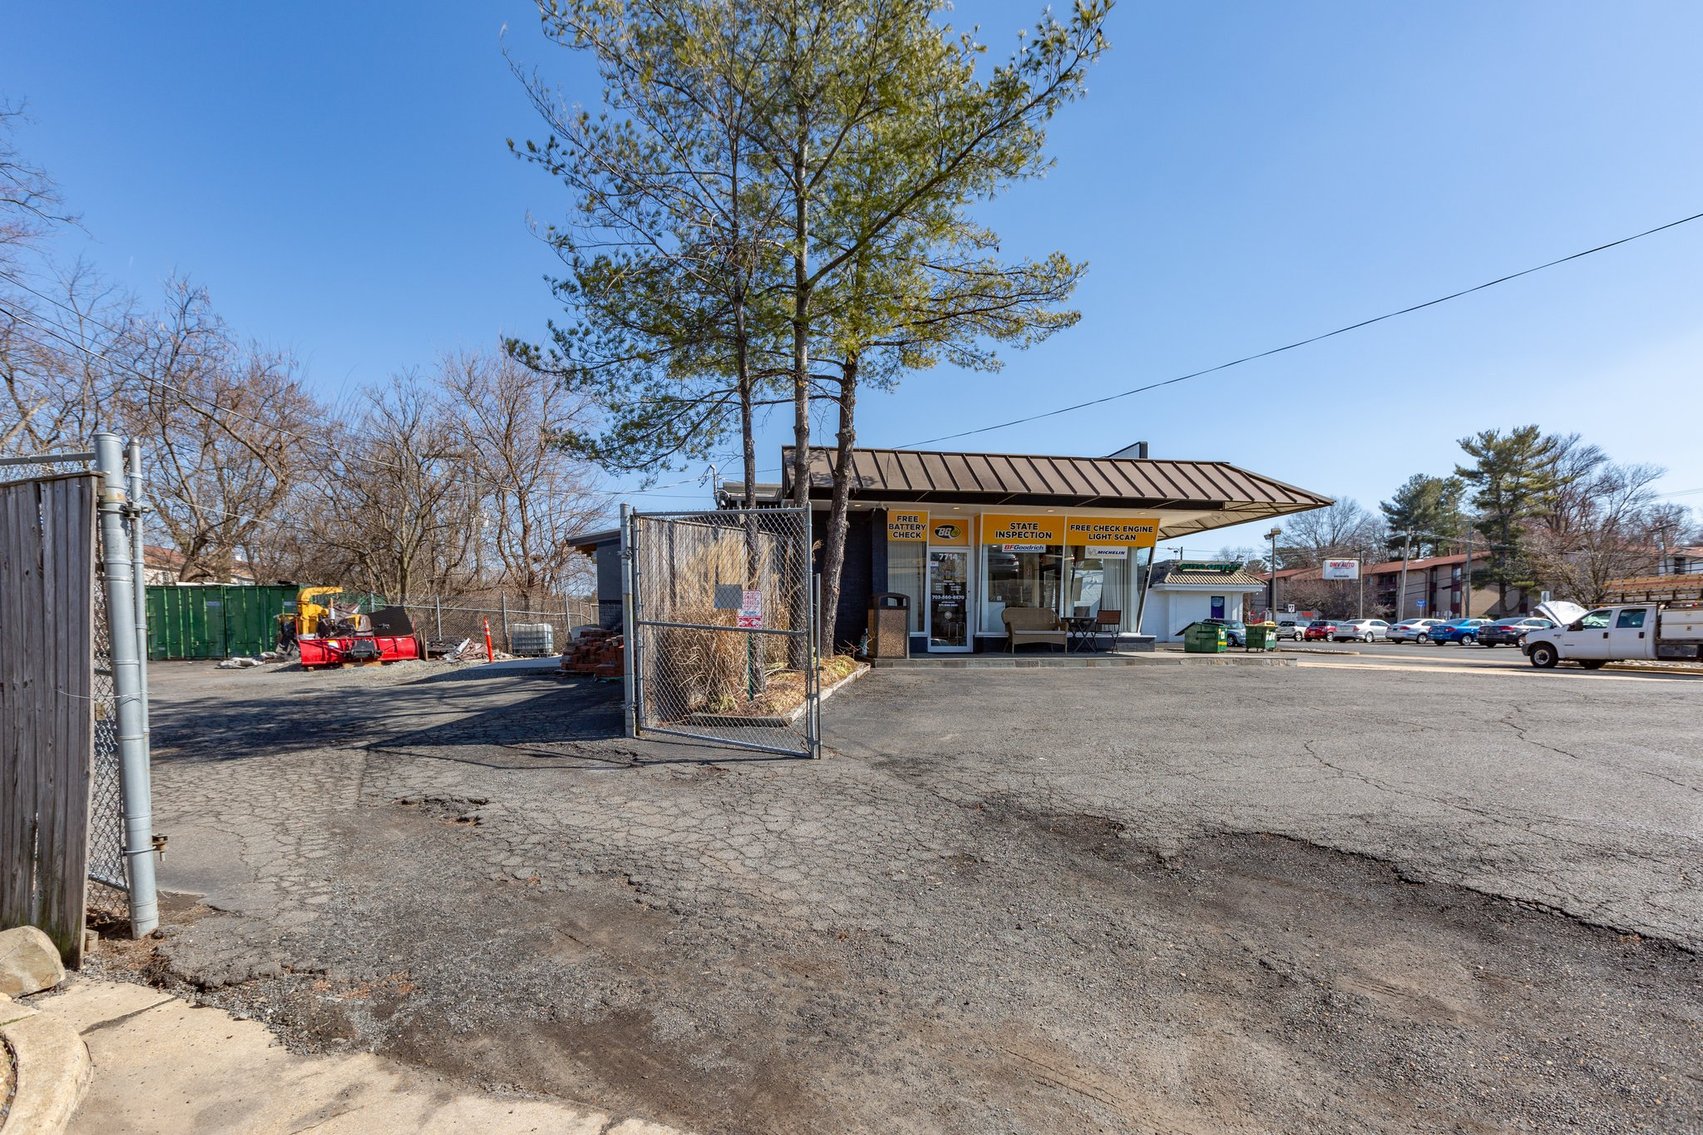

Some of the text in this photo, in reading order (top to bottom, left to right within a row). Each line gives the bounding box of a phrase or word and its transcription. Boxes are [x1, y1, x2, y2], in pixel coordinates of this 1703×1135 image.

[896, 515, 919, 523] FREE
[888, 523, 927, 531] BATTERY
[1010, 522, 1039, 531] STATE
[1070, 524, 1154, 533] FREE CHECK ENGINE
[892, 531, 922, 539] CHECK
[995, 531, 1053, 540] INSPECTION
[1088, 533, 1137, 542] LIGHT SCAN
[1003, 544, 1045, 552] BFGoodrich
